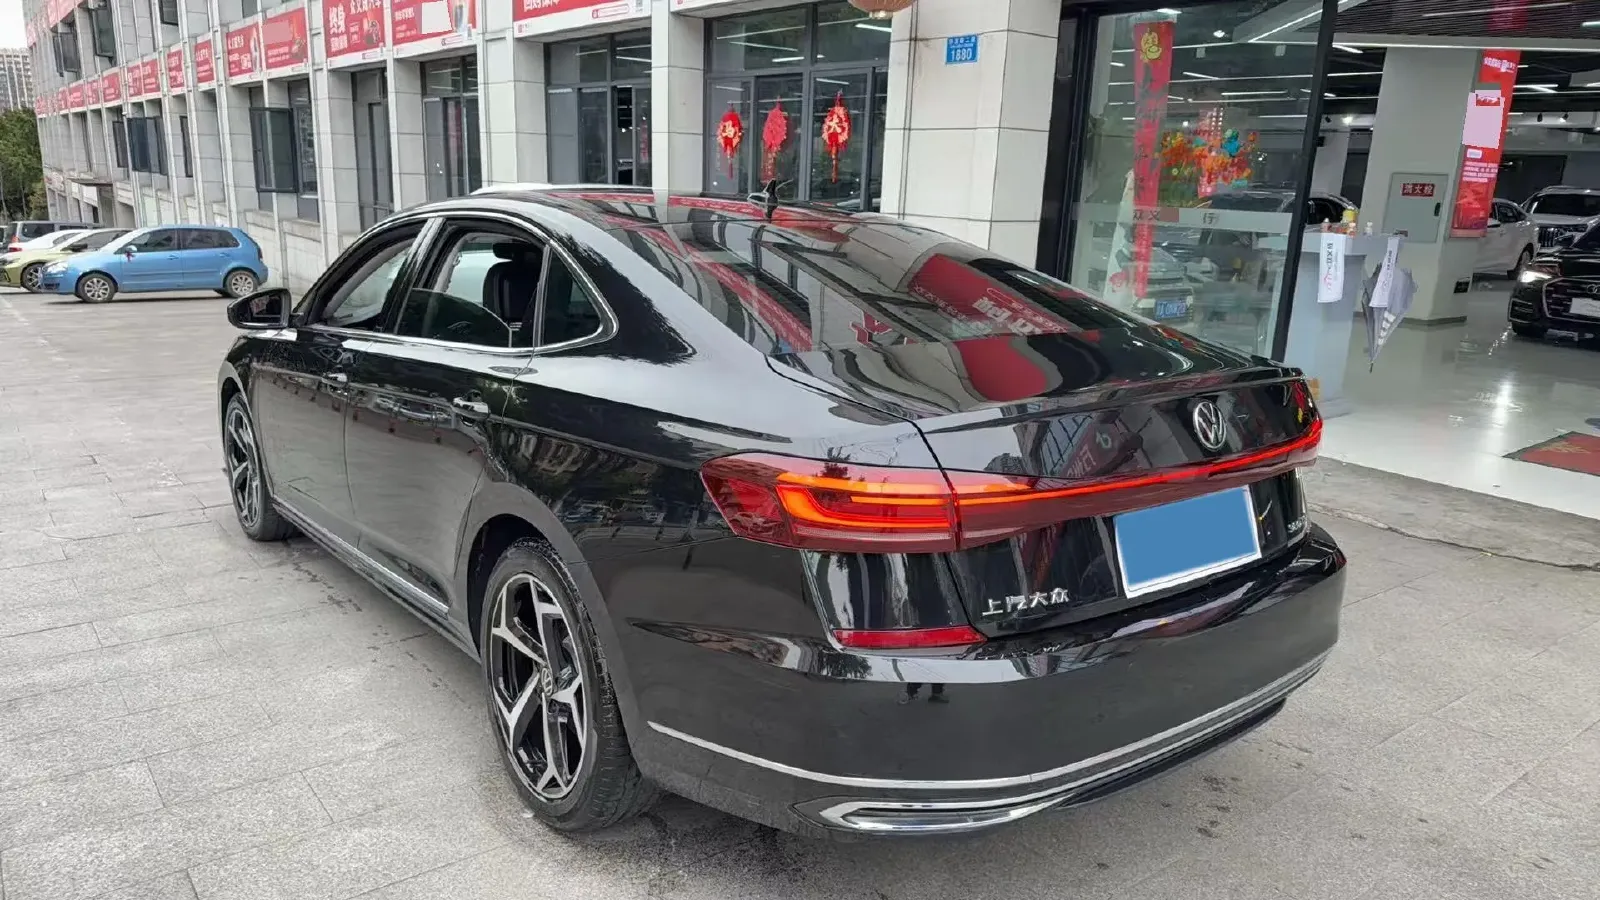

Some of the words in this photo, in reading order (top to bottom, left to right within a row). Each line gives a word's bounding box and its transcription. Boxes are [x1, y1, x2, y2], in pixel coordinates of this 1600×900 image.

[950, 48, 972, 62] 1880
[982, 587, 1070, 616] 上汽大众
